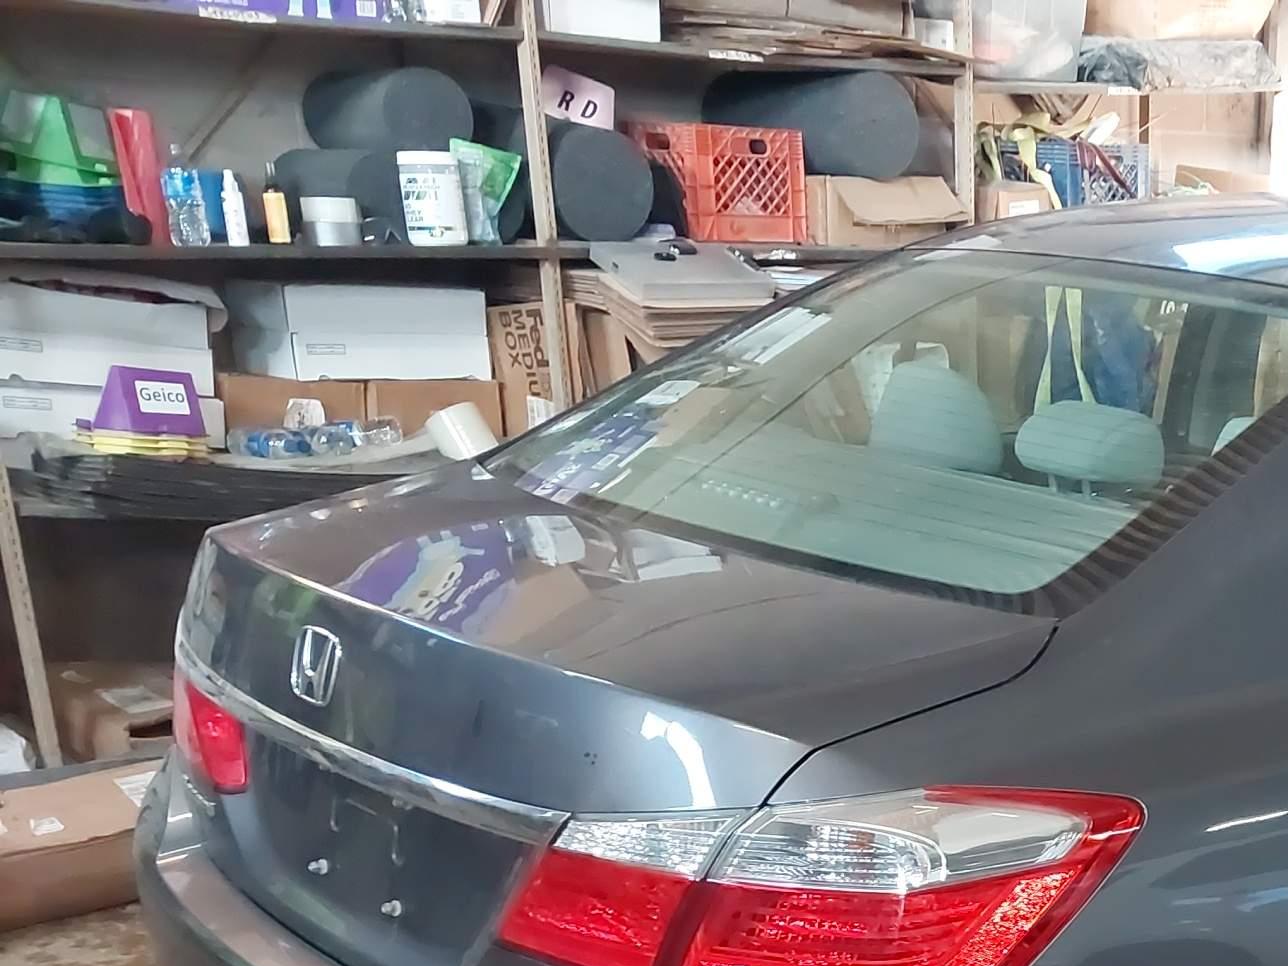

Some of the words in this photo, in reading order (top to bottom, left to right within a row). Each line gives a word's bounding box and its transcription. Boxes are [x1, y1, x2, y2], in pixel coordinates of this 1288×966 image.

[557, 89, 575, 112] R
[580, 99, 598, 119] D
[498, 311, 522, 368] BOX
[511, 309, 541, 397] MEDIU
[140, 387, 185, 403] Geico
